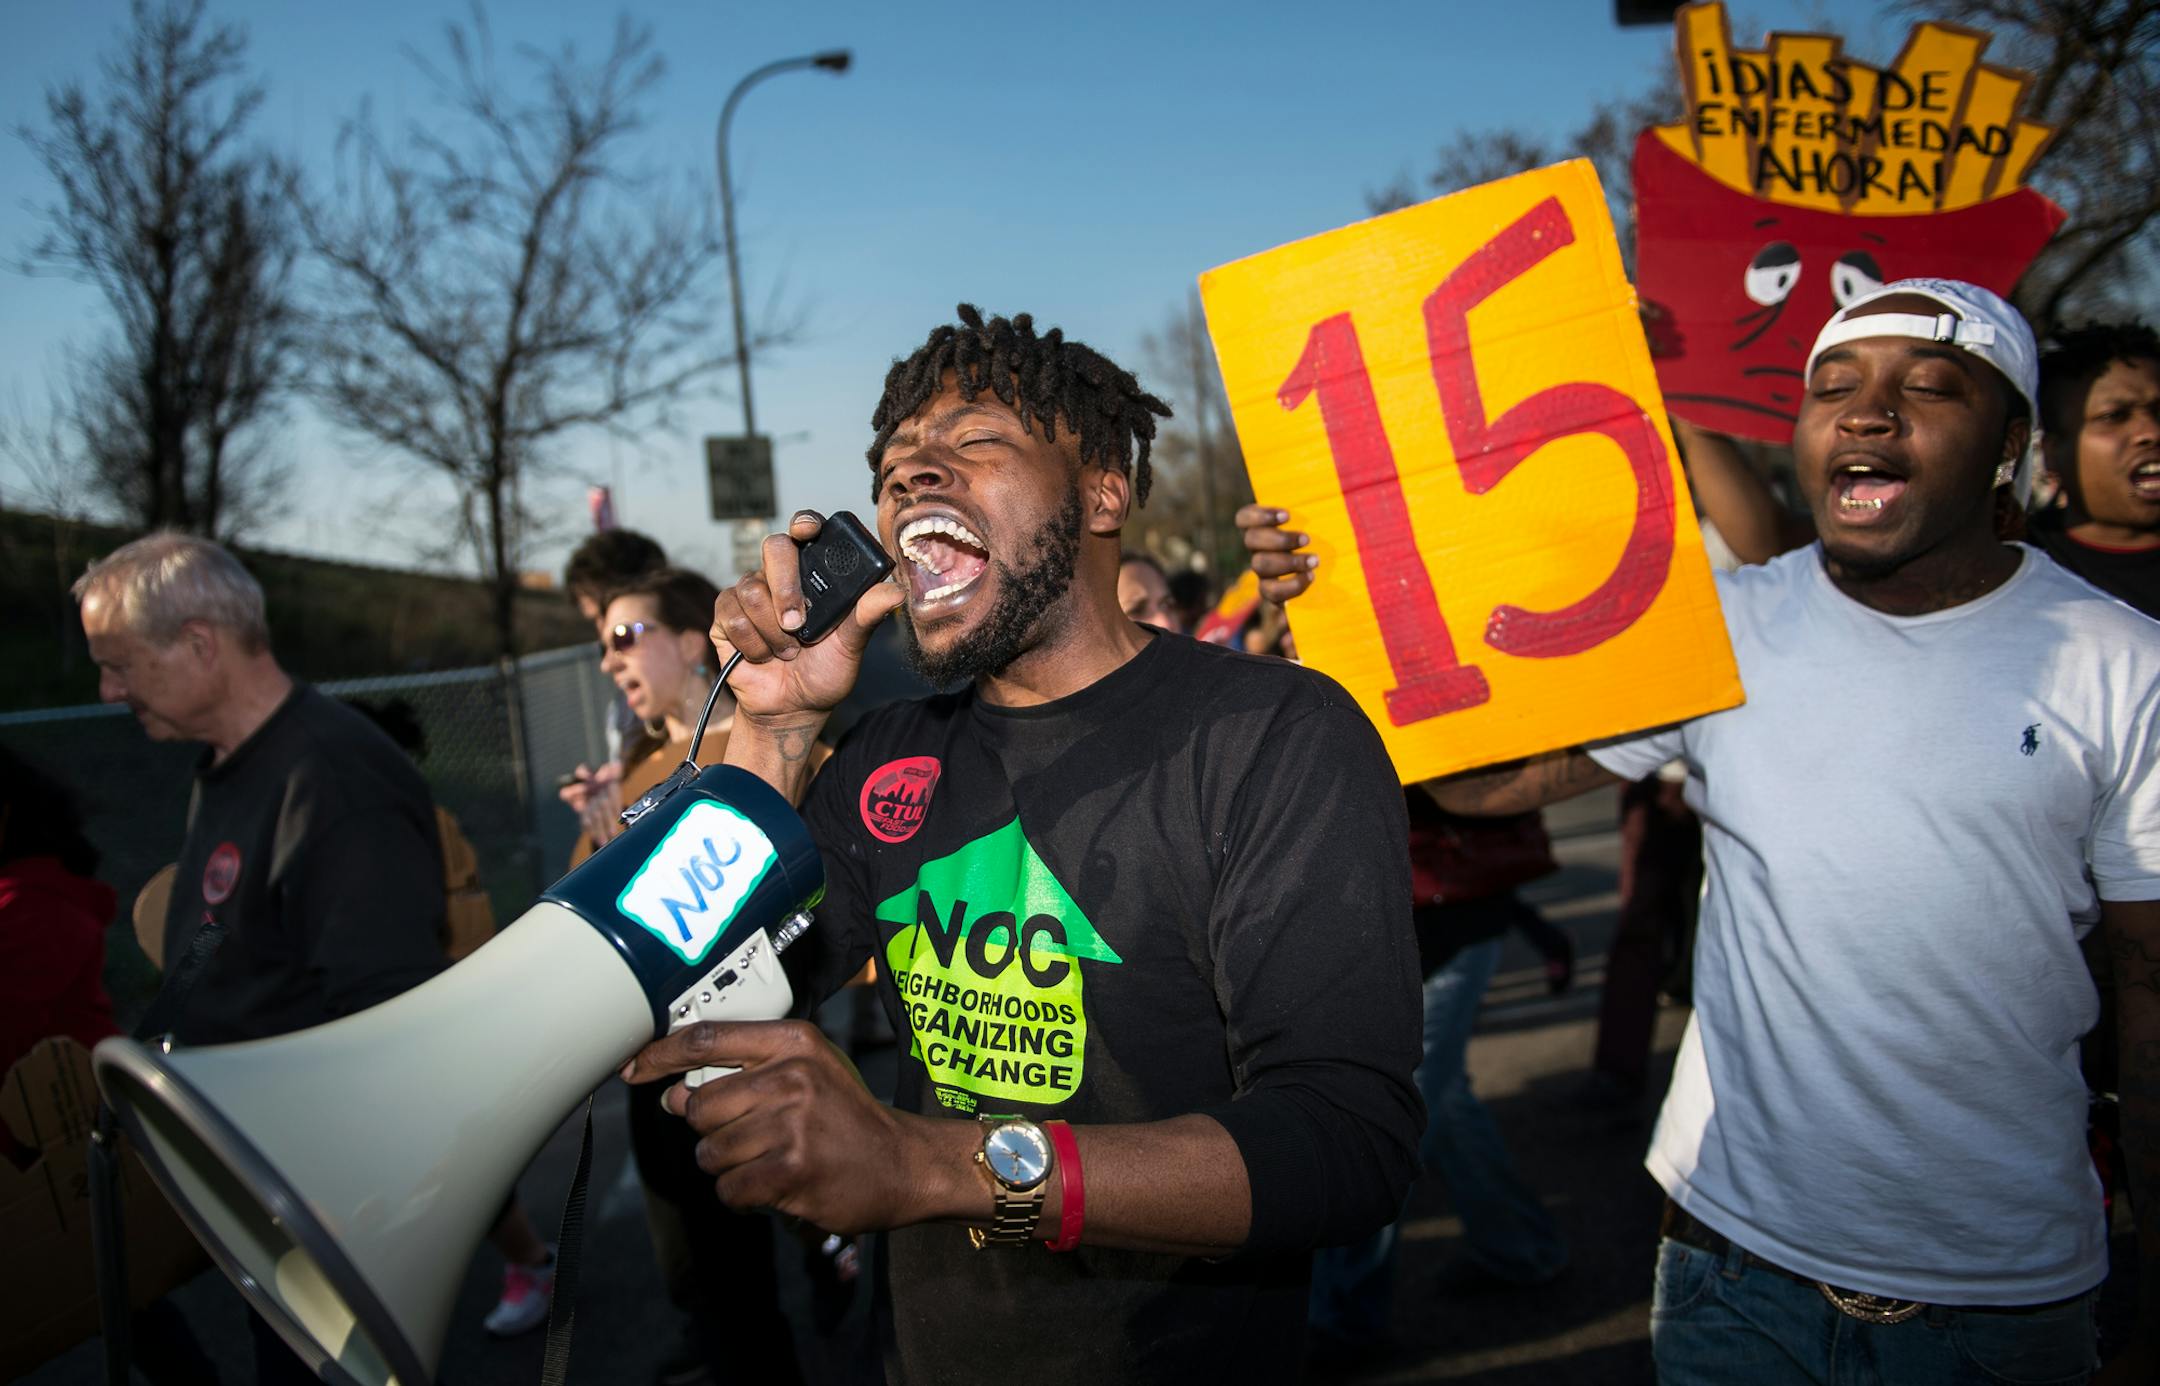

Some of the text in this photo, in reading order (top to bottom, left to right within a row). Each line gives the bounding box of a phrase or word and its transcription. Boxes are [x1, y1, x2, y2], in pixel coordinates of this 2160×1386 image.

[1876, 70, 1952, 112] DE
[1696, 102, 2014, 158] ENFERMEDAD
[1752, 143, 1944, 208] AHORA!
[1277, 195, 1676, 727] 15
[660, 837, 742, 943] NOC
[909, 889, 1072, 989] NOC
[902, 999, 1074, 1058] GANIZING
[927, 1041, 1073, 1091] CHANGE
